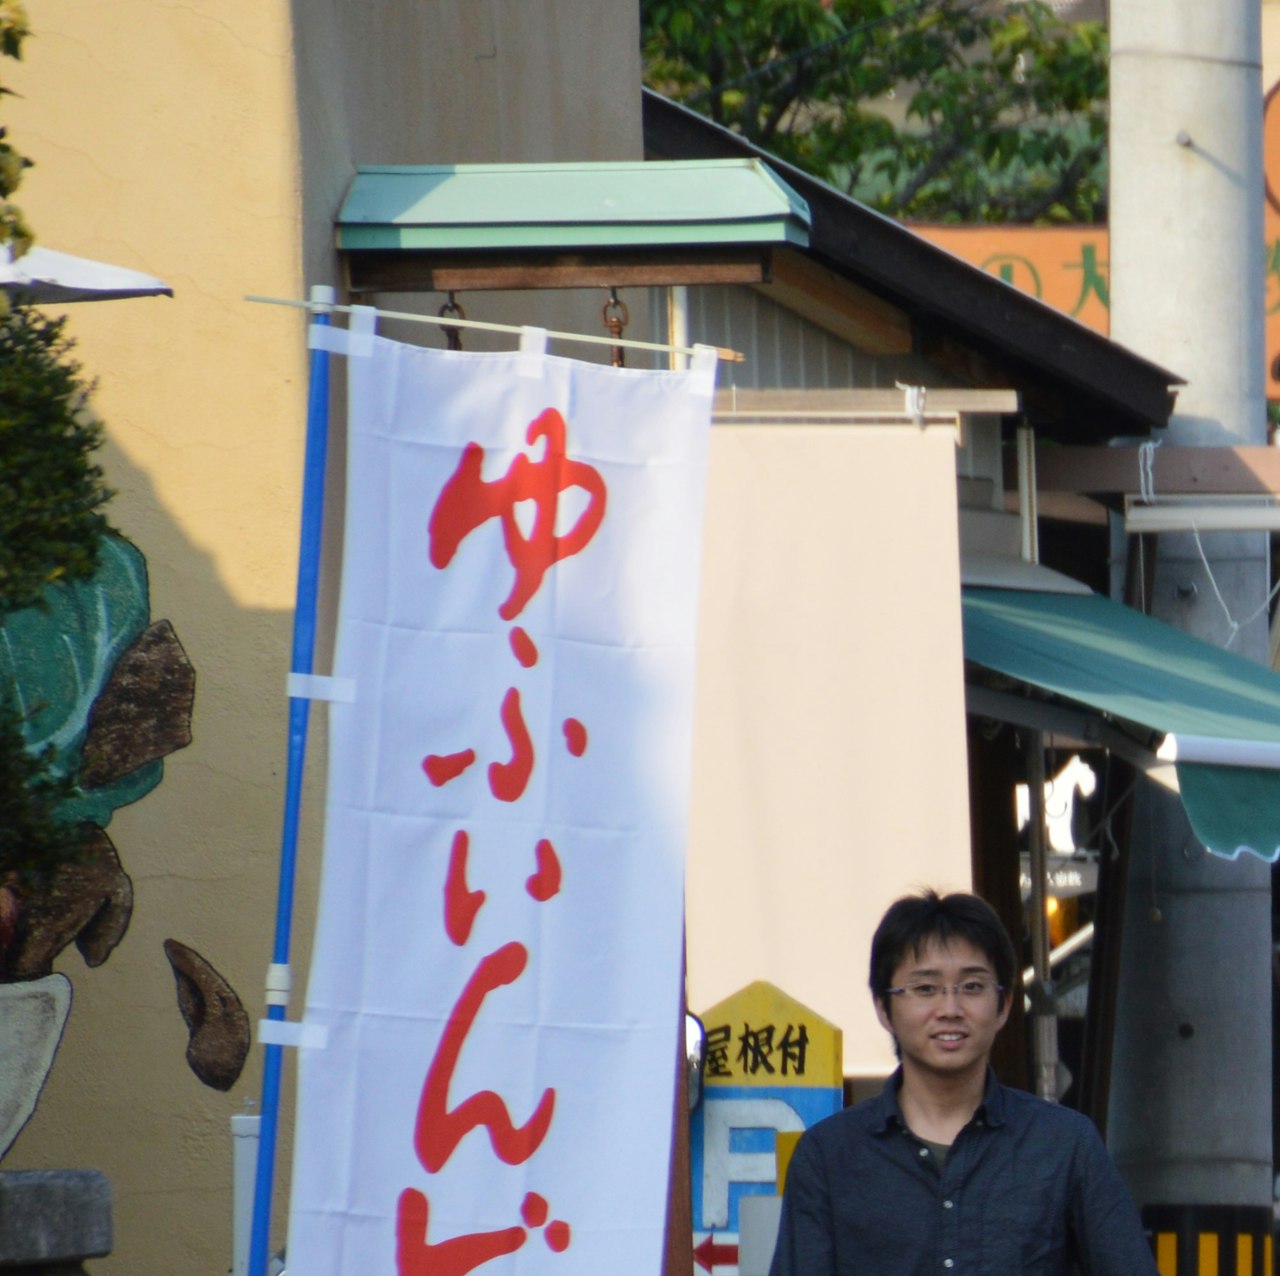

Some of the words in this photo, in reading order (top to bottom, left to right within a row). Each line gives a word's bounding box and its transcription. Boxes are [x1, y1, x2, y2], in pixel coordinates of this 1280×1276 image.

[703, 1022, 810, 1078] 屋根付
[702, 1099, 805, 1229] P
